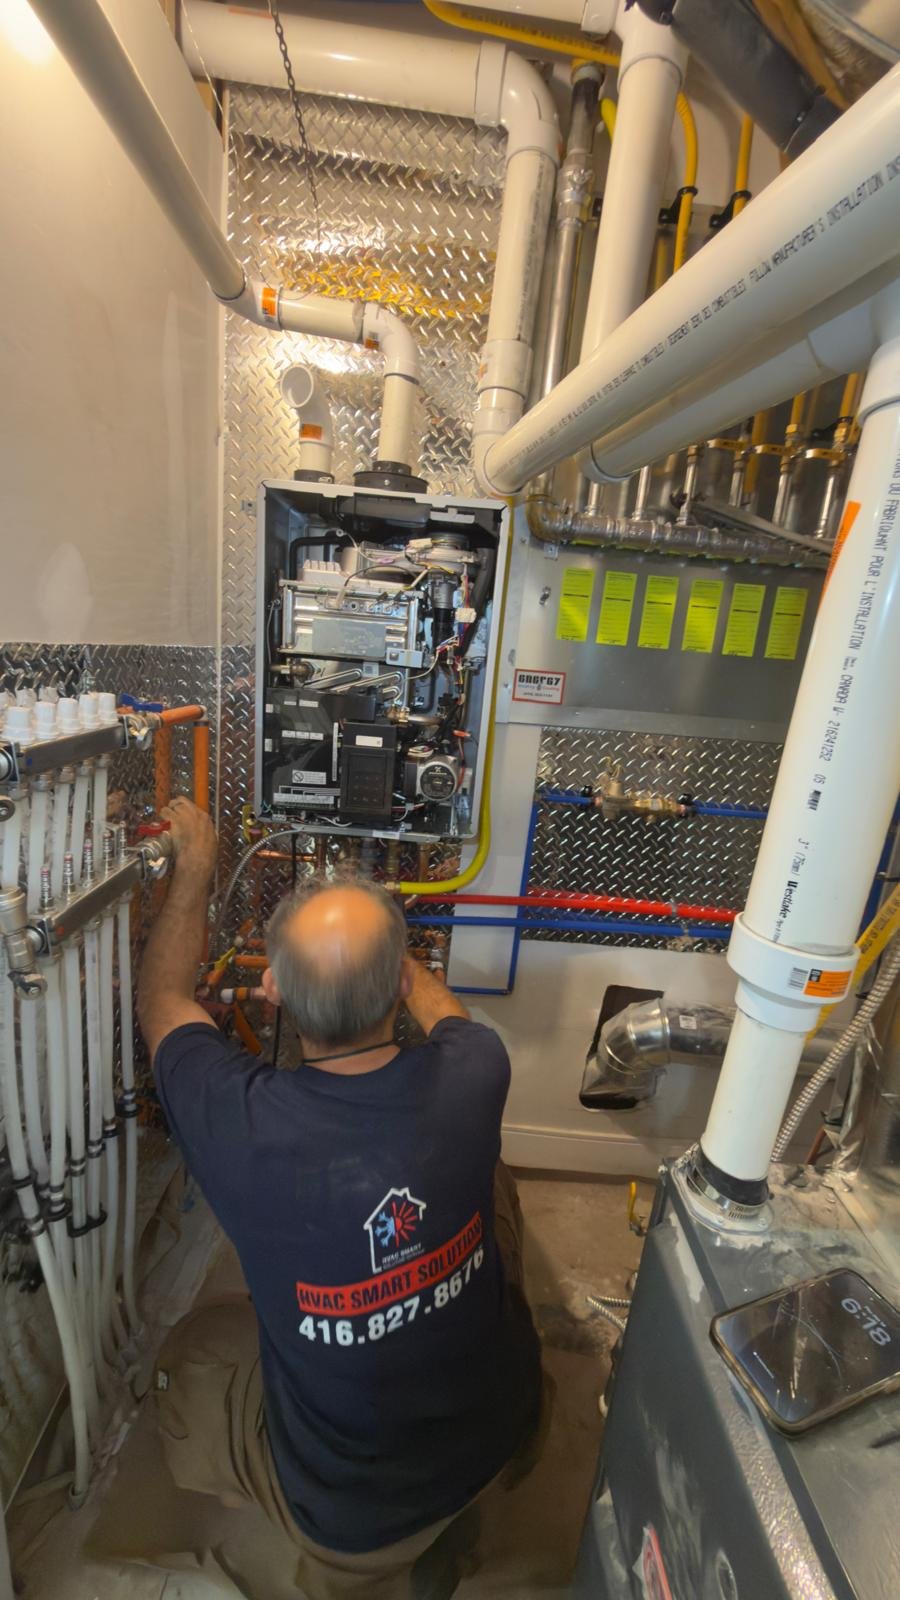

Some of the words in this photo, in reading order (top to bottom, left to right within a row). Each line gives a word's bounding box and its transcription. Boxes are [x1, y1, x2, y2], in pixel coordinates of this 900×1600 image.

[866, 555, 884, 577] POUR
[834, 674, 854, 704] CANADA
[779, 880, 799, 919] Westlake
[299, 1287, 345, 1311] HVAC
[351, 1272, 413, 1308] SMART
[841, 1298, 891, 1346] 6:18
